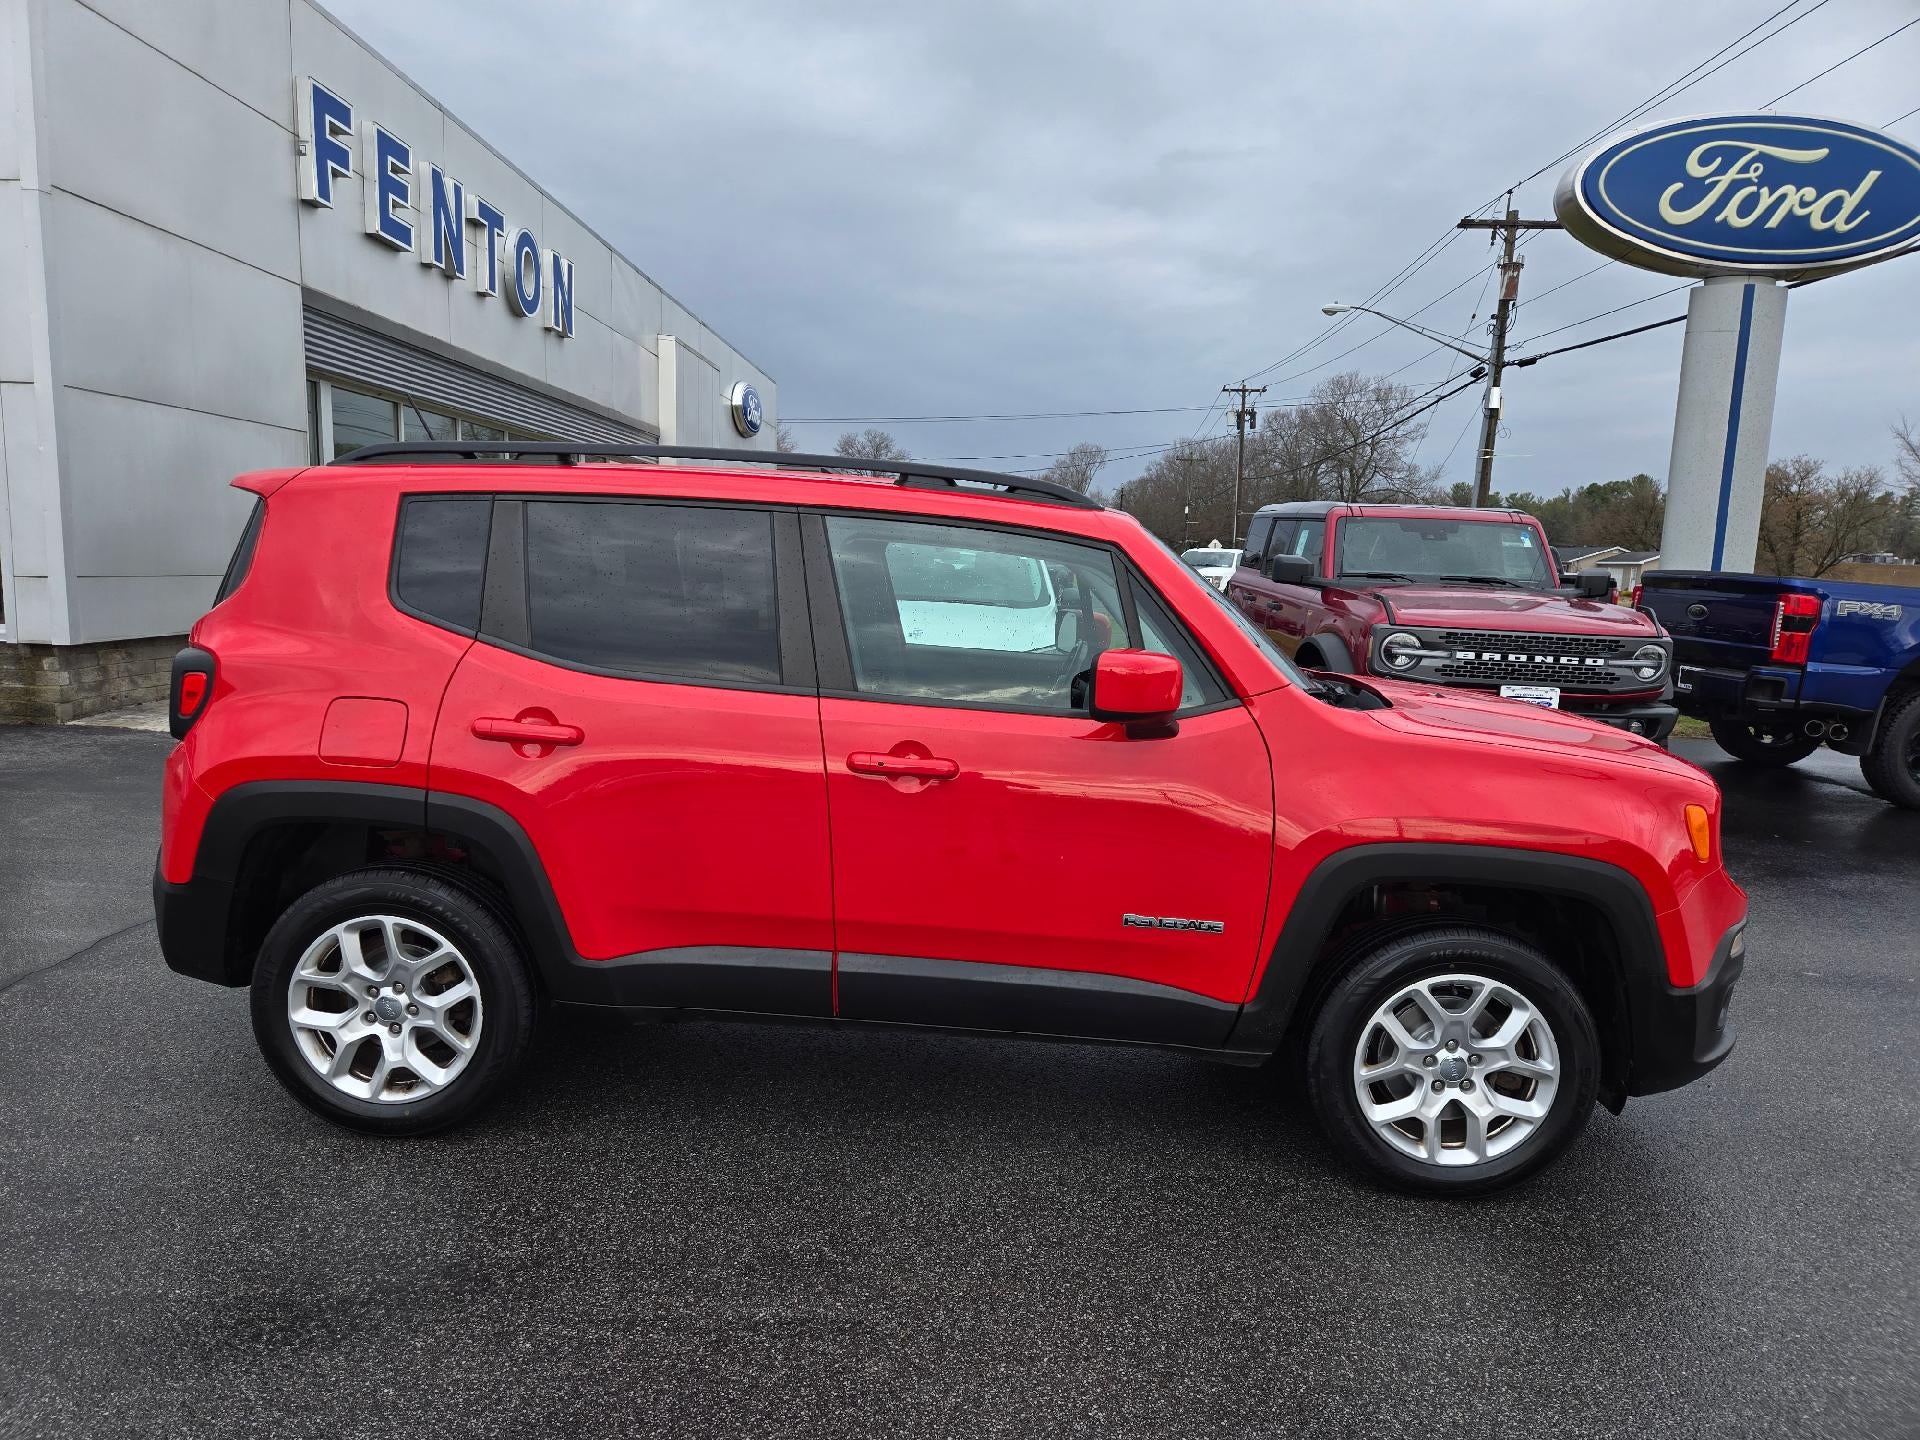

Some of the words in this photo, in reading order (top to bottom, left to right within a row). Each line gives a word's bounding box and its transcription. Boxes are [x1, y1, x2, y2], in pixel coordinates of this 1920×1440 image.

[1658, 140, 1883, 234] Ford
[302, 77, 575, 338] FENTON
[1836, 600, 1902, 619] FX4
[1455, 650, 1605, 667] BRONCO
[1122, 913, 1225, 934] RENEGADE
